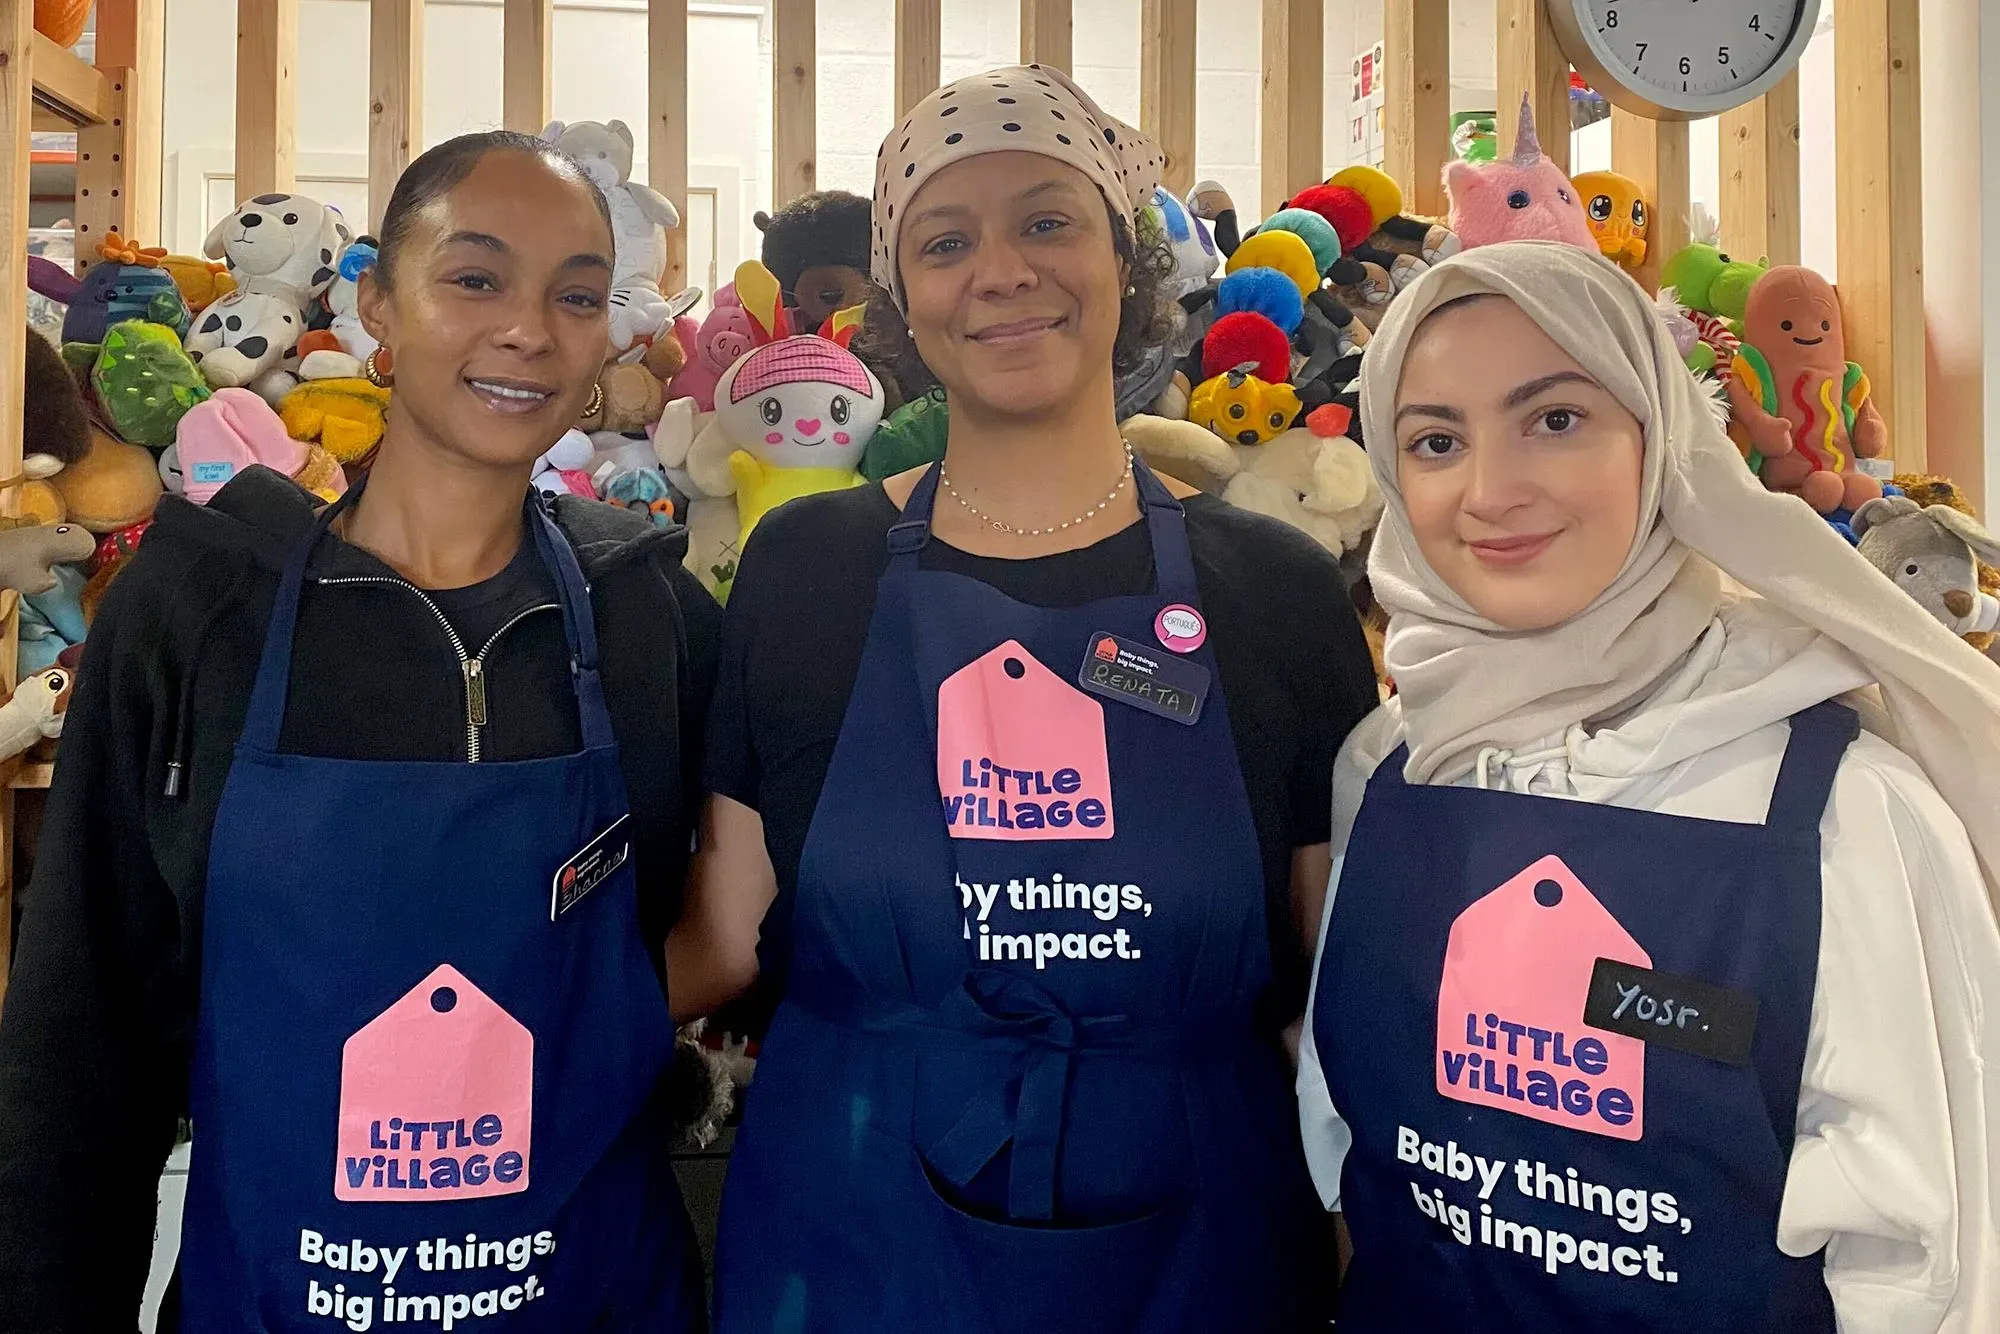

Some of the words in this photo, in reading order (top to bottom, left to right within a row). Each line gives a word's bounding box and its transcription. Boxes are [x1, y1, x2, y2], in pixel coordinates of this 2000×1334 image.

[1606, 9, 1619, 29] 8
[1748, 14, 1761, 33] 4
[1635, 43, 1648, 62] 7
[1678, 56, 1691, 75] 6
[1717, 46, 1730, 65] 5
[1117, 657, 1128, 668] big
[1119, 649, 1137, 662] Baby
[1092, 664, 1181, 711] RENATA
[1006, 872, 1153, 921] things,
[978, 923, 1141, 970] impact.
[1397, 1125, 1506, 1200] Baby
[1514, 1158, 1693, 1235] things,
[1410, 1181, 1473, 1246] big
[1480, 1203, 1679, 1283] impact.
[299, 1228, 409, 1284] Baby
[415, 1230, 556, 1272] things,
[307, 1279, 374, 1332] big
[383, 1274, 545, 1331] impact.
